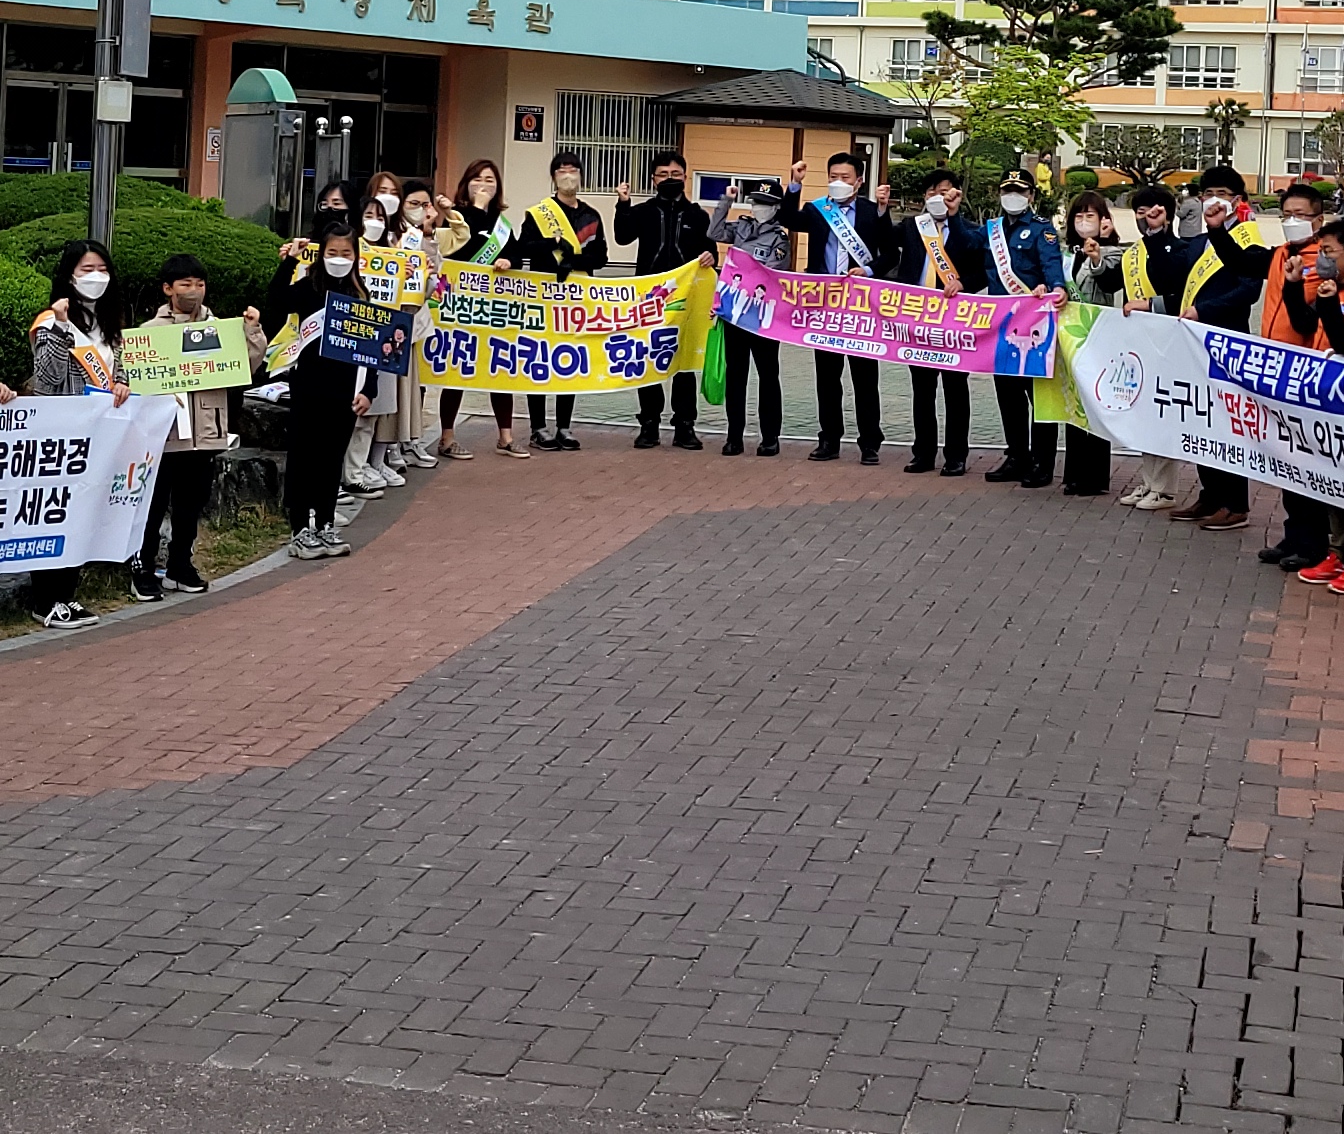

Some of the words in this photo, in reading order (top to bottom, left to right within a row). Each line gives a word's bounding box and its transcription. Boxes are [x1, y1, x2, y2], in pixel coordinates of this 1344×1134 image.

[459, 272, 489, 294] 안전을
[493, 275, 537, 299] 생각하는
[541, 282, 583, 301] 건강한
[590, 285, 635, 302] 어린이
[376, 309, 392, 323] 장난
[439, 292, 546, 331] 산청초등학교
[553, 297, 665, 332] 119소년단
[879, 287, 948, 325] 행복한
[955, 299, 997, 329] 학교
[791, 309, 876, 337] 산청경찰과
[881, 319, 910, 343] 함께
[914, 325, 977, 351] 만들어요
[810, 334, 845, 349] 학교폭력
[846, 338, 864, 351] 신고
[866, 341, 881, 353] 117
[144, 365, 176, 380] 친구를
[179, 360, 214, 377] 병들게
[216, 360, 241, 372] 합니다
[424, 328, 477, 375] 안전
[489, 336, 589, 382] 지킴이
[606, 328, 678, 377] 활동
[913, 349, 954, 364] 산청경찰서
[1209, 333, 1283, 396] 학교폭력
[1285, 354, 1327, 406] 발견
[161, 379, 200, 391] 산청초등학교
[1153, 376, 1214, 427] 누구나
[1181, 433, 1245, 467] 경남무지개센터
[1248, 449, 1266, 473] 산청
[13, 486, 72, 526] 세상
